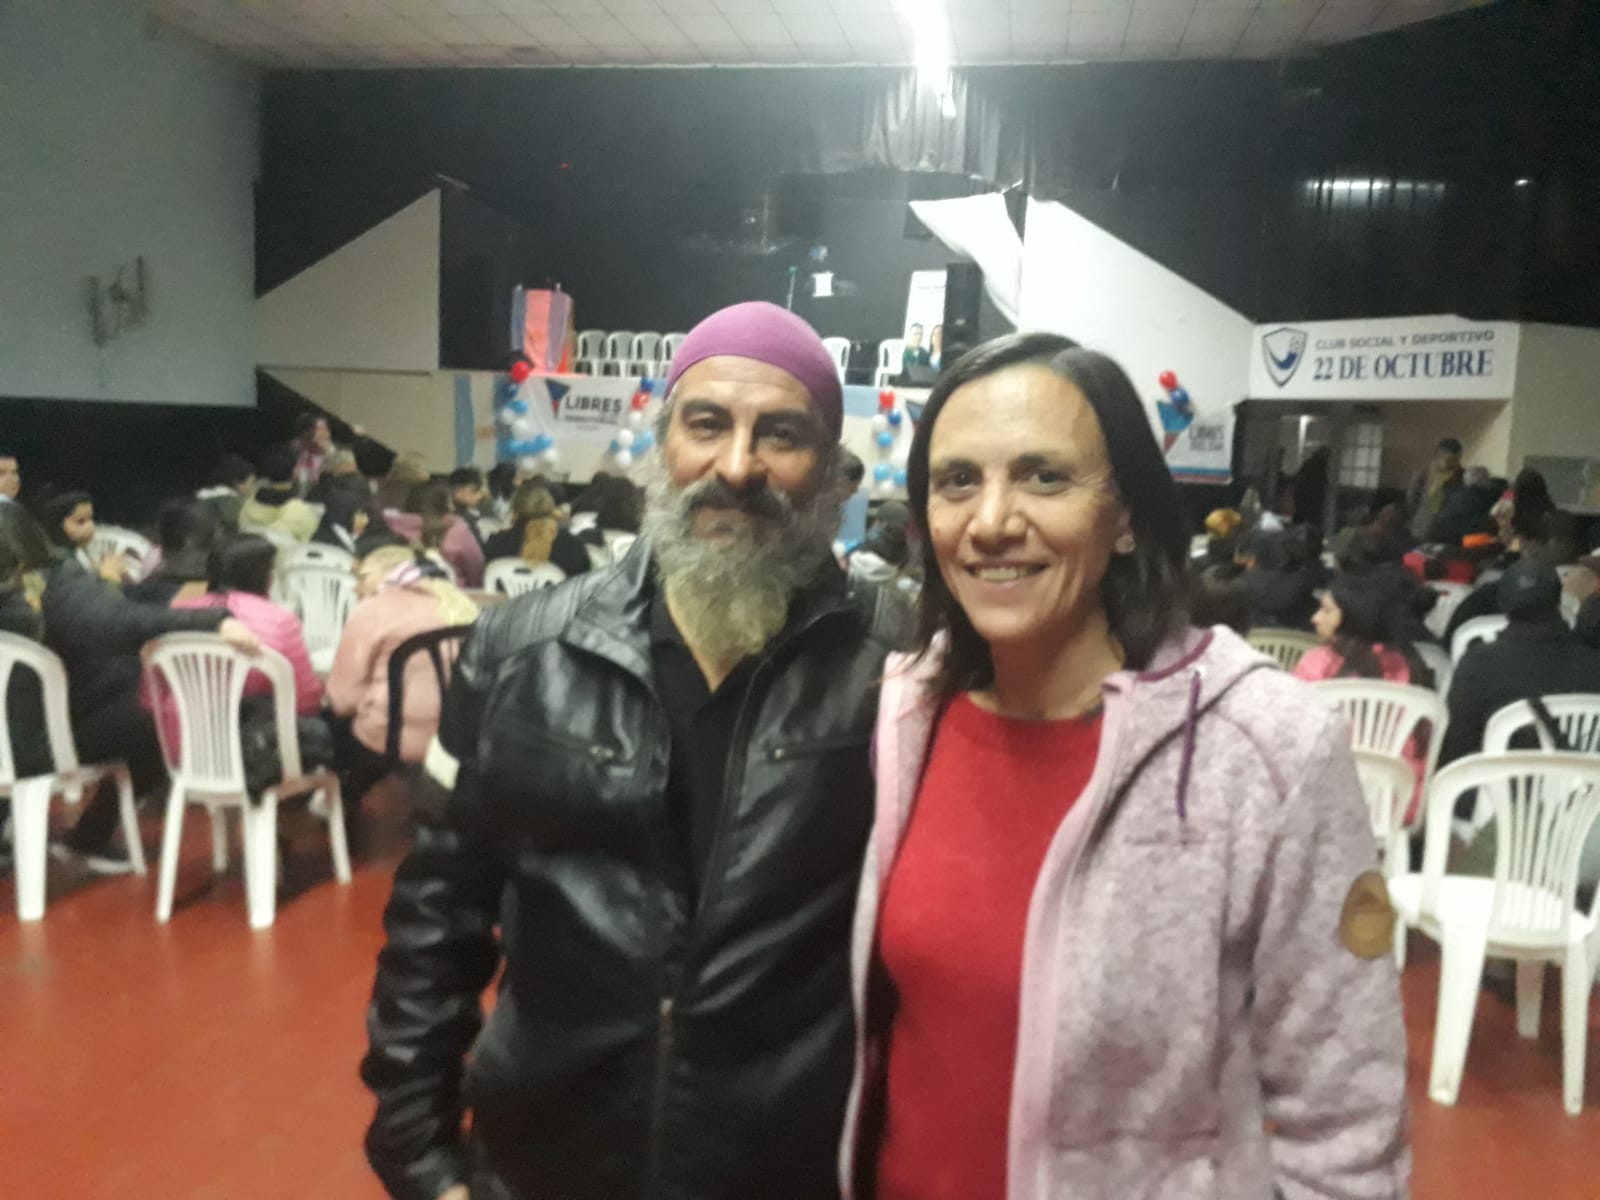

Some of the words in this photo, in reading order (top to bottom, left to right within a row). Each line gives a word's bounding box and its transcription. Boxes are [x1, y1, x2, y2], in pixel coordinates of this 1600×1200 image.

[1315, 338, 1346, 349] CLUB
[1350, 336, 1394, 348] SOCIAL
[1401, 335, 1408, 346] Y
[1412, 330, 1495, 346] DEPORTIVO
[1313, 356, 1333, 380] 22
[1339, 355, 1369, 380] DE
[1375, 350, 1493, 379] OCTUBRE
[565, 396, 622, 413] LIBRES
